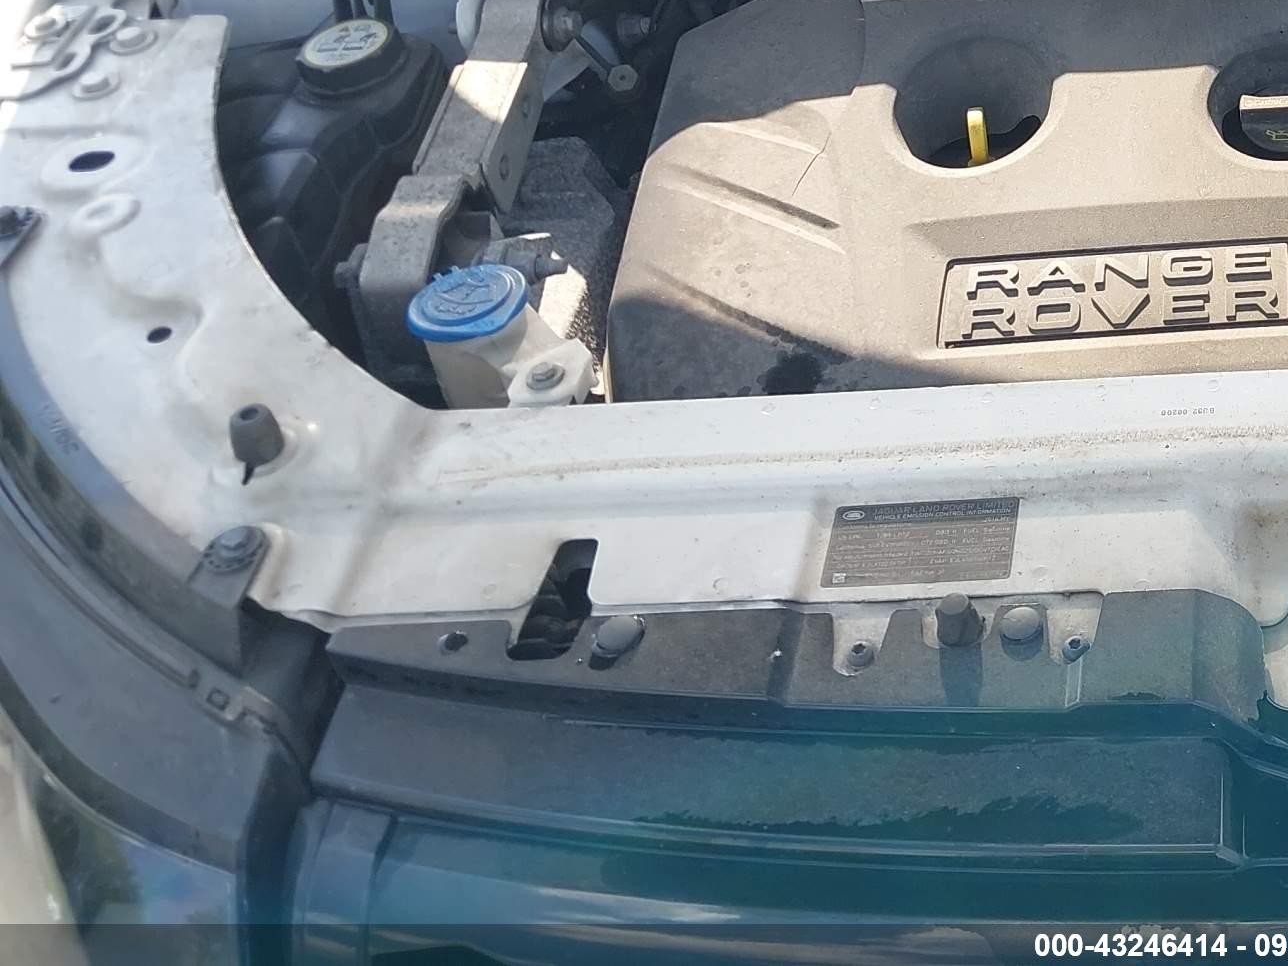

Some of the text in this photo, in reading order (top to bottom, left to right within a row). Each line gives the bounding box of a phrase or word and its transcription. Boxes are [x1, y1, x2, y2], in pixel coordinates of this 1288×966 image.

[966, 247, 1273, 301] RANGE
[962, 286, 1281, 339] ROVER
[941, 503, 975, 511] ROVER
